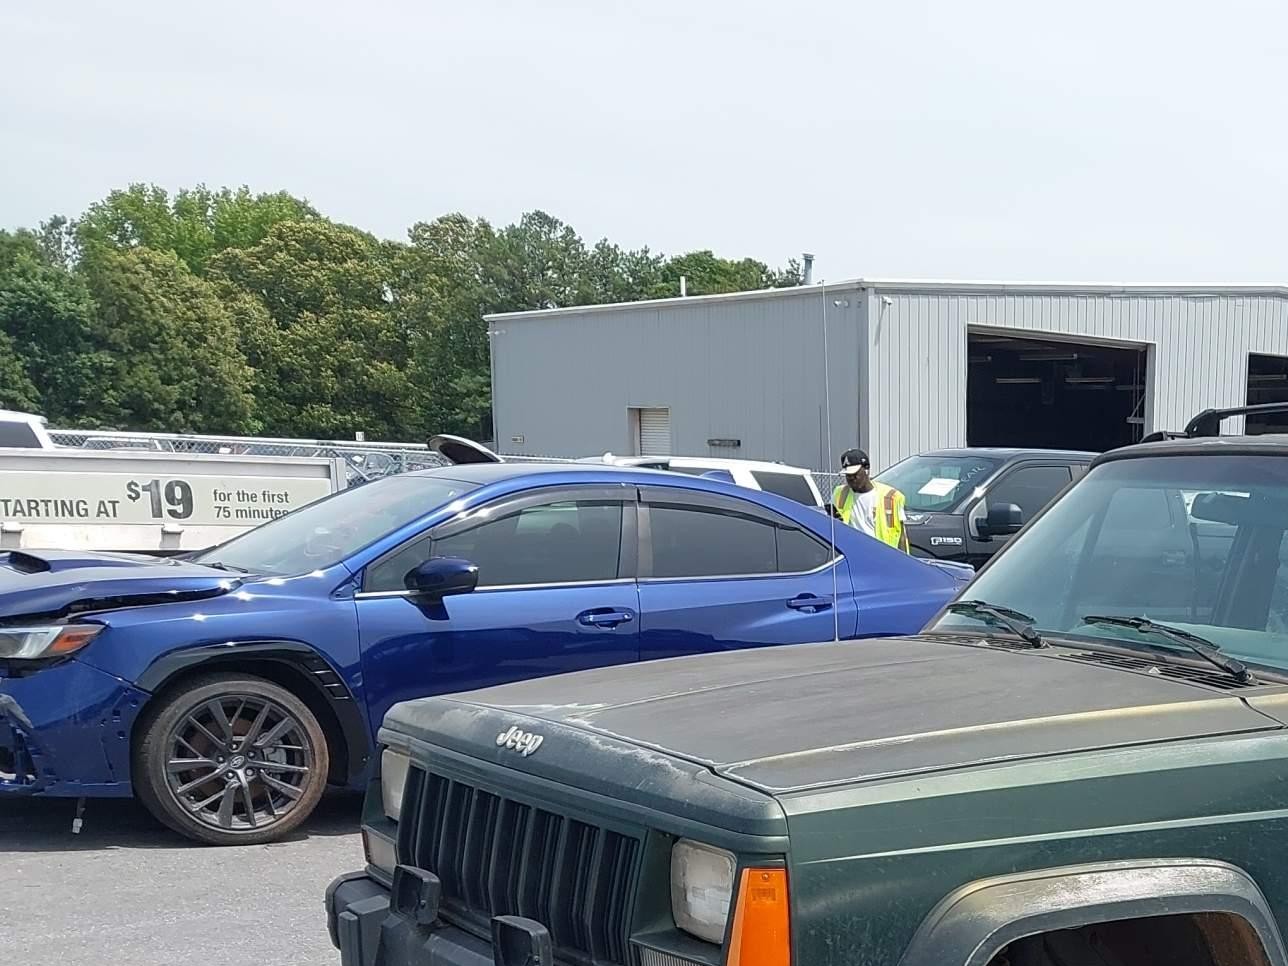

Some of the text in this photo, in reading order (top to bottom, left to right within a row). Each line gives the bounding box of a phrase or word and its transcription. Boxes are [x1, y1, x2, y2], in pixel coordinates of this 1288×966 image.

[95, 500, 120, 518] AT
[126, 479, 194, 520] $19
[213, 489, 290, 504] for the first
[214, 506, 231, 519] 75
[496, 726, 544, 757] Jeep
